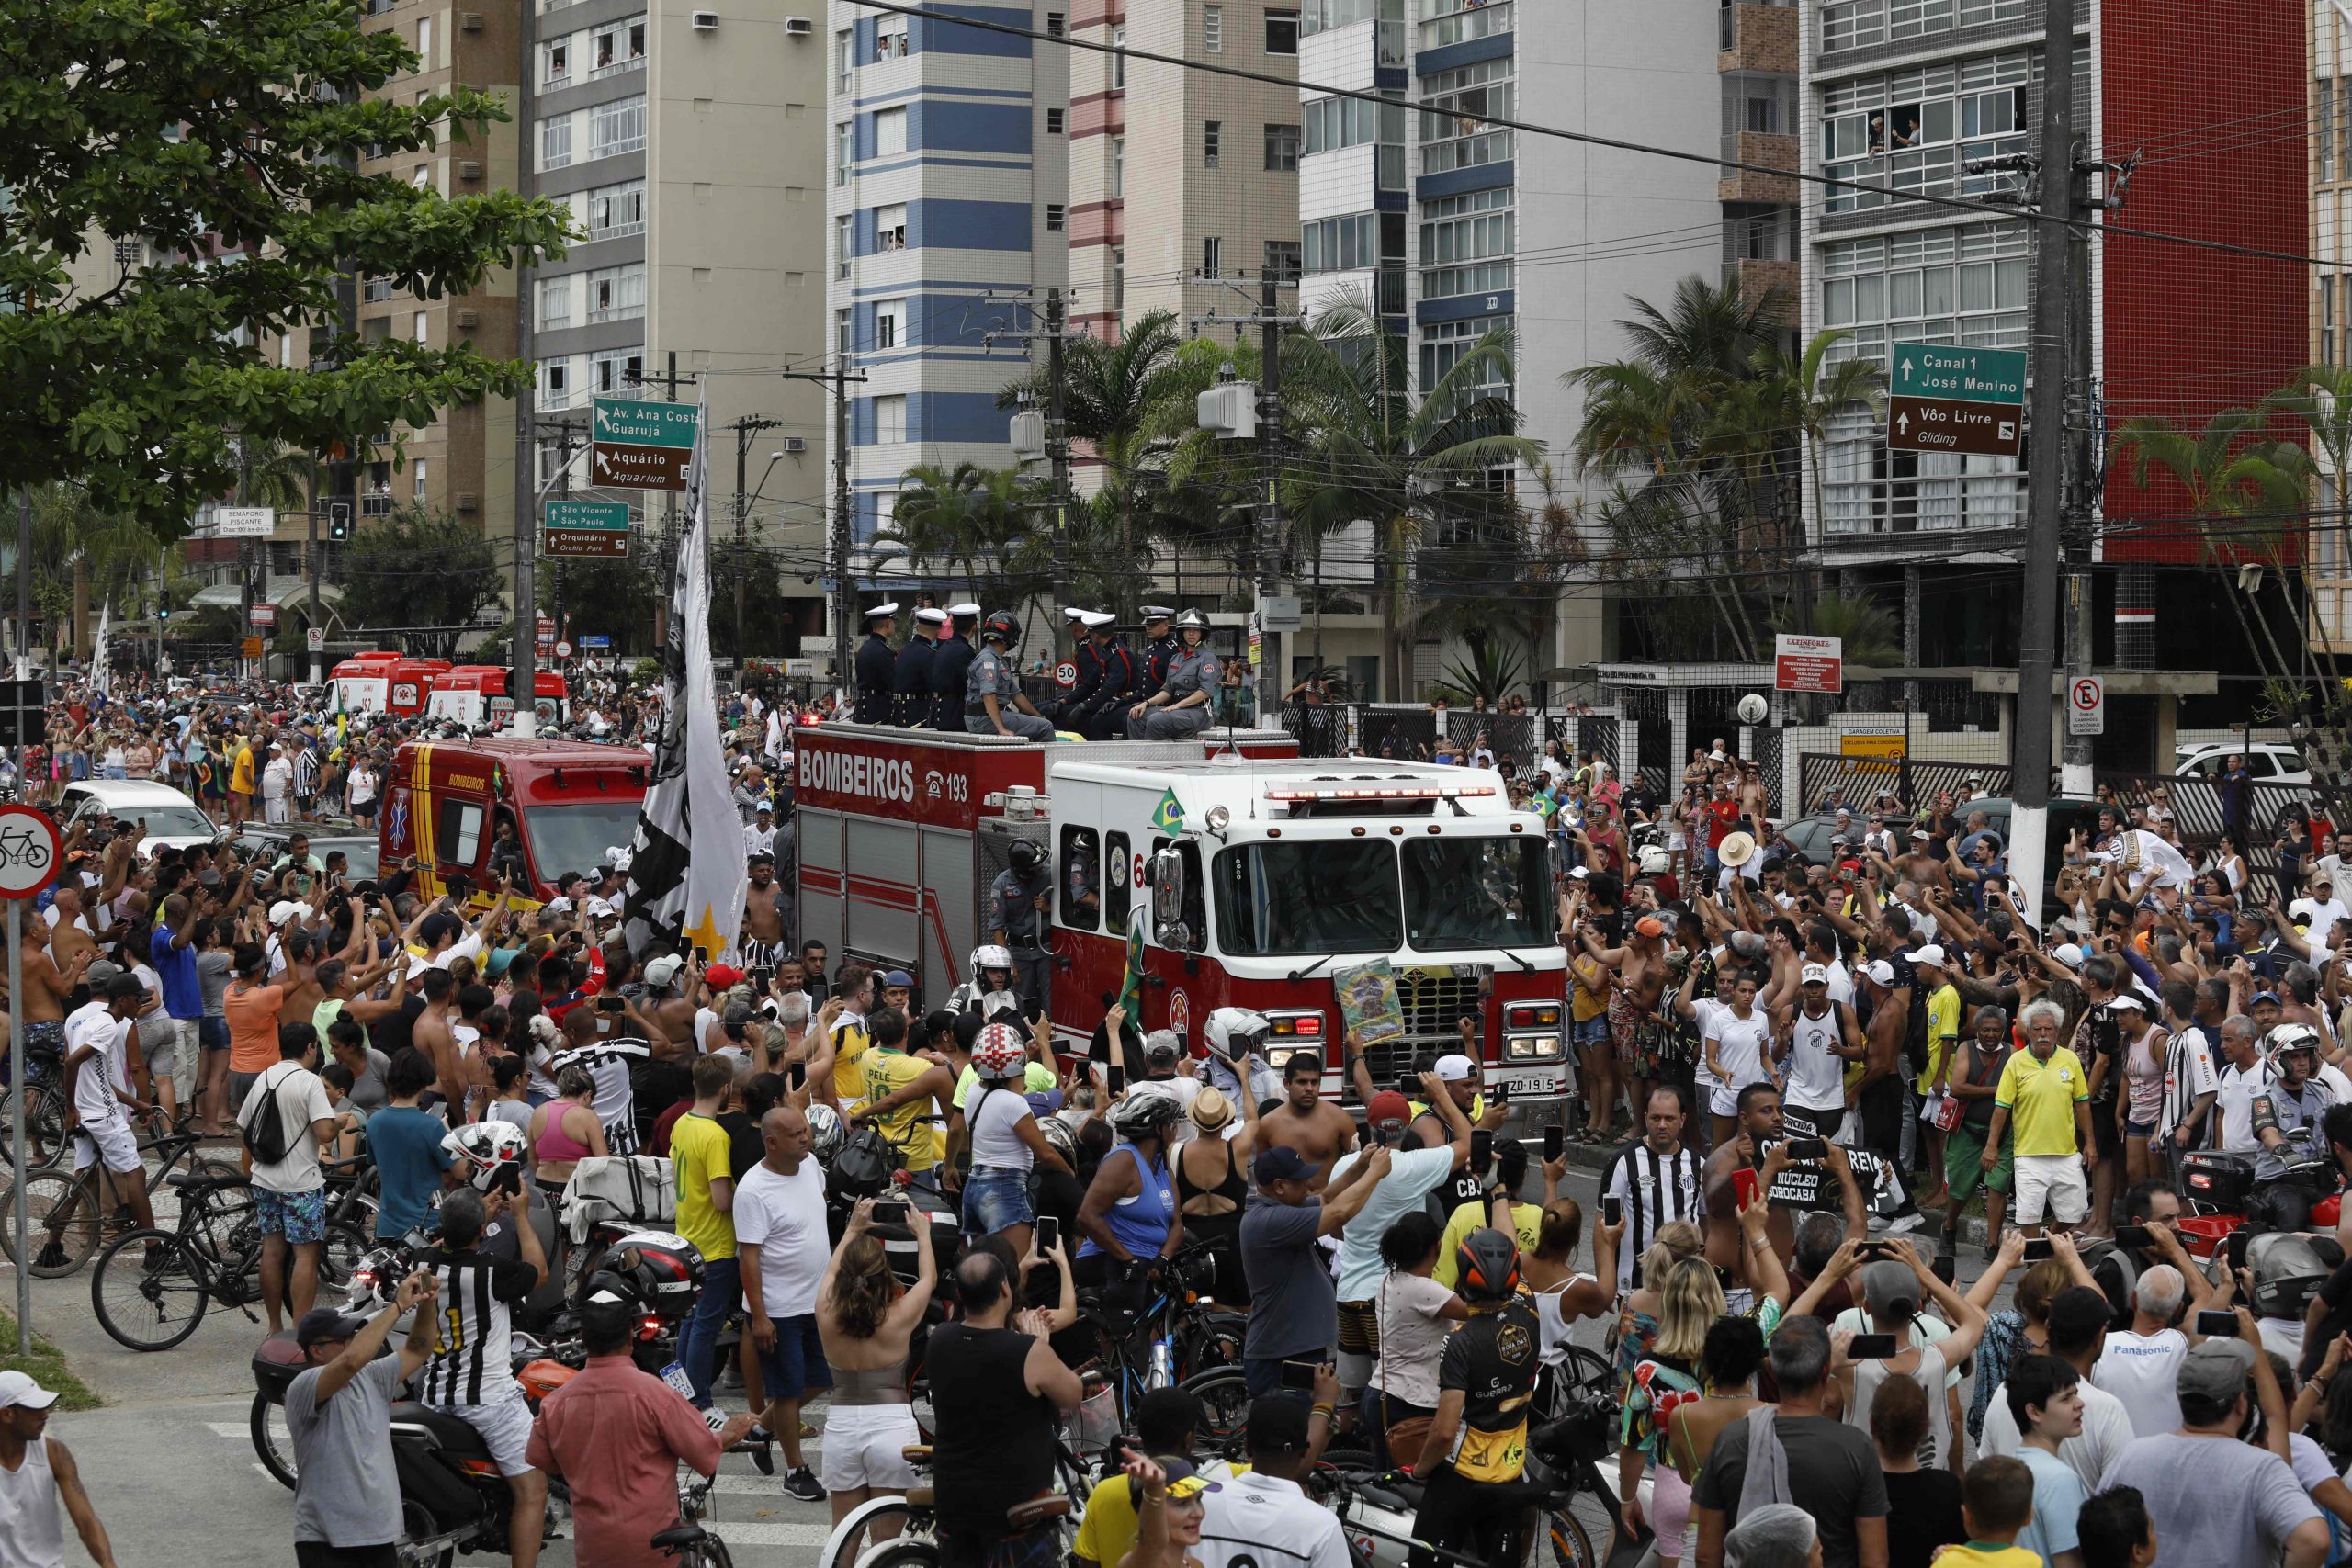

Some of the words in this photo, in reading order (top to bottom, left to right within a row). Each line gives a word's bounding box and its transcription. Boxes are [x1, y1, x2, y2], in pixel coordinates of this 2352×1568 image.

[1923, 354, 1965, 369] Canal
[1970, 357, 1976, 370] 1
[1922, 374, 1957, 388] José
[1965, 377, 2017, 392] Menino
[613, 407, 629, 418] Av.
[636, 411, 659, 421] Ana
[1920, 408, 1946, 422] Vôo
[1955, 410, 1992, 424] Livre
[611, 423, 660, 438] Guarujá
[1918, 431, 1957, 447] Gliding
[612, 451, 666, 465] Aquário
[612, 471, 666, 484] Aquarium
[560, 533, 607, 543] Orquidário
[1059, 667, 1074, 678] 50
[362, 698, 372, 712] 192
[492, 709, 514, 721] 192
[449, 774, 485, 791] BOMBEIROS
[799, 749, 914, 802] BOMBEIROS
[947, 773, 967, 802] 193
[1133, 853, 1144, 889] 6
[1804, 966, 1824, 976] TJS
[868, 1069, 891, 1082] PELÉ
[1504, 1079, 1553, 1091] ZD-1915
[1777, 1170, 1818, 1187] NÚCLEO
[2114, 1344, 2171, 1356] Panasonic
[1021, 1507, 1043, 1517] YAMADA
